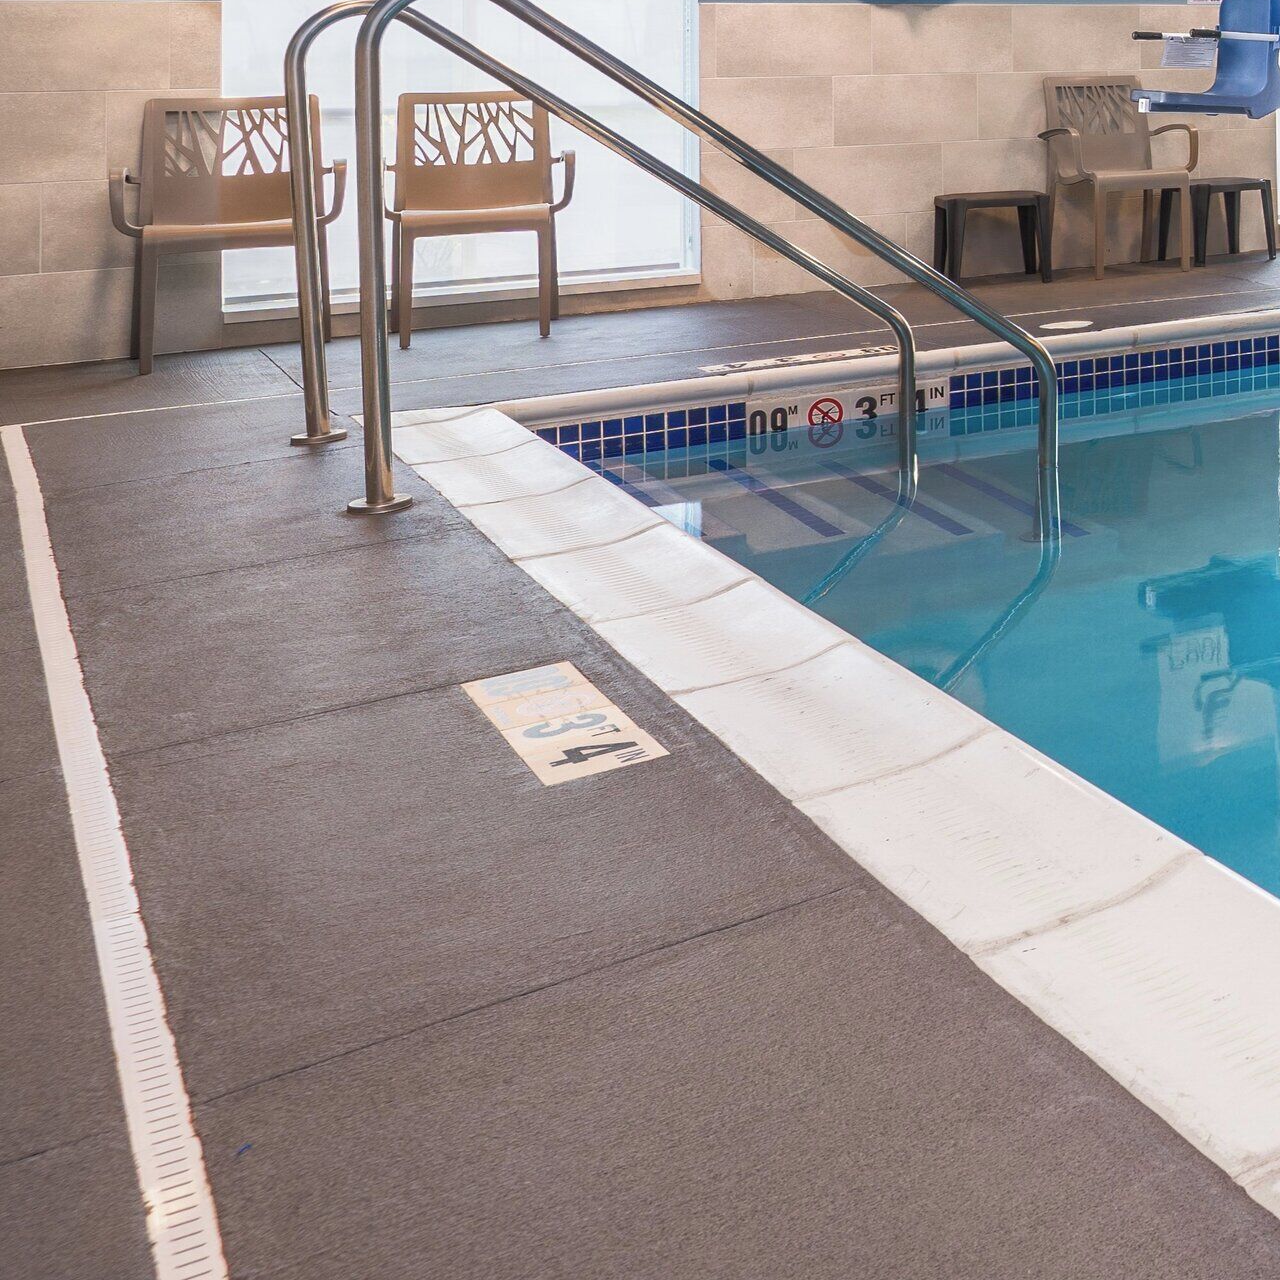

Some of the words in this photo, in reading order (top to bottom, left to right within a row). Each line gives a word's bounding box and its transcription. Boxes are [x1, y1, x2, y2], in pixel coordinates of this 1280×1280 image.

[788, 405, 798, 416] M
[880, 392, 896, 407] FT
[930, 385, 945, 400] IN
[522, 712, 608, 739] 3
[586, 723, 621, 738] FT
[548, 741, 639, 767] 4
[614, 748, 651, 764] IN
